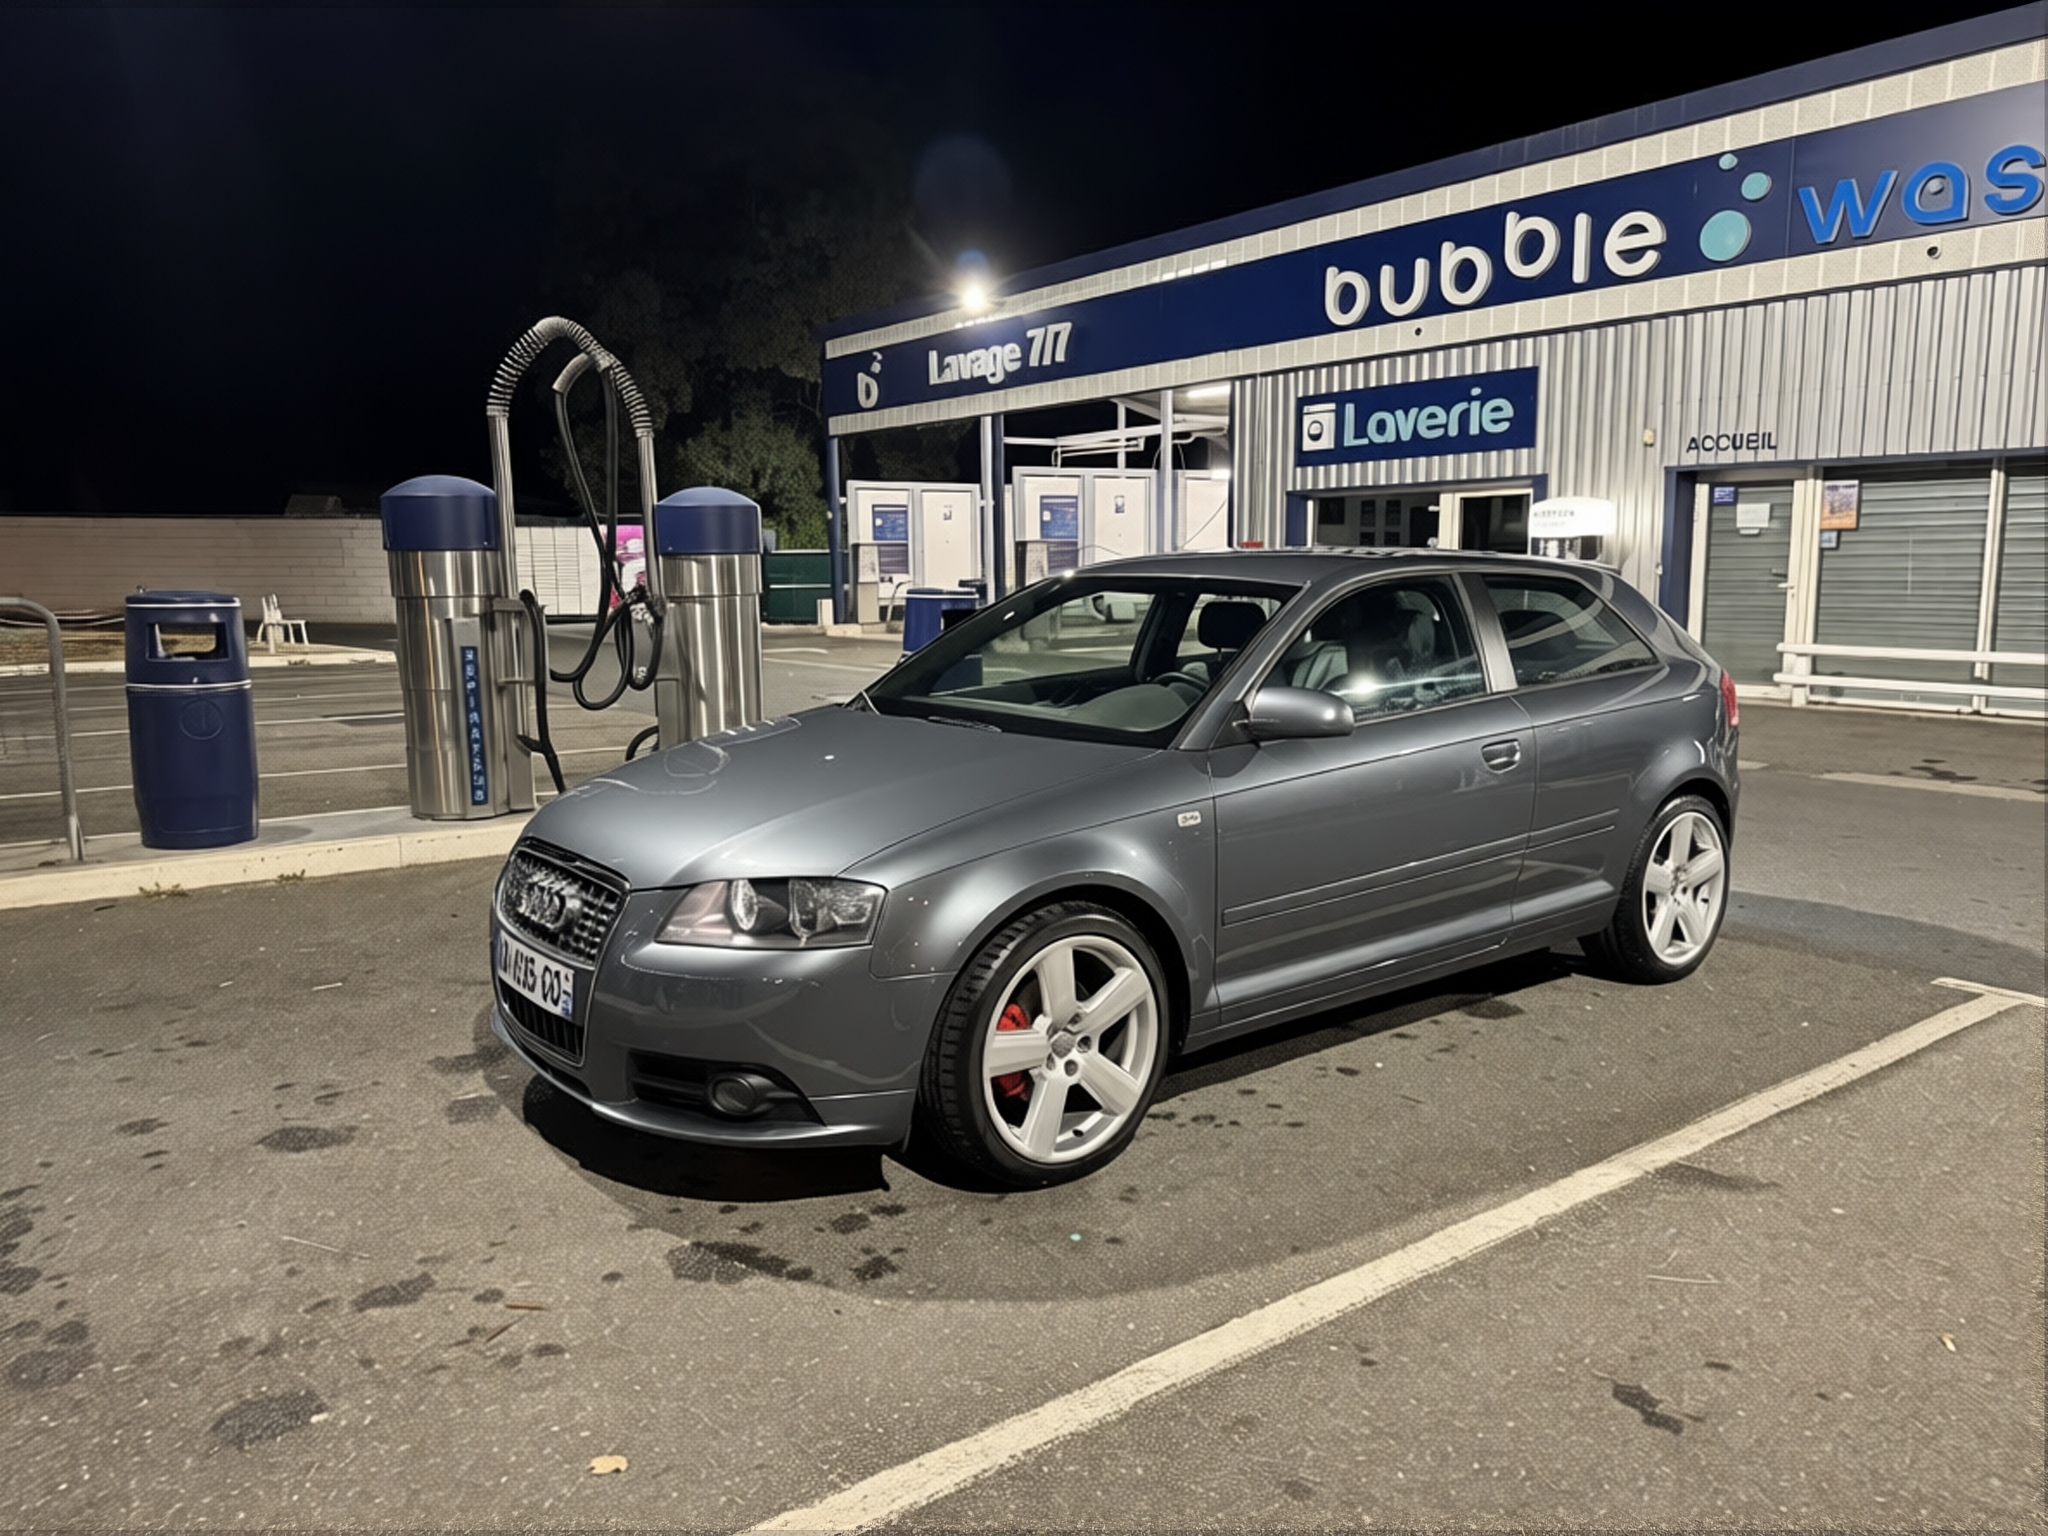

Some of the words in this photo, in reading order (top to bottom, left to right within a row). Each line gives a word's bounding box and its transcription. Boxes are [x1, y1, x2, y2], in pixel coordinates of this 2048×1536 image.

[1324, 210, 1667, 326] bubble
[1798, 144, 2047, 245] was
[928, 342, 1022, 386] Lavage
[1343, 386, 1514, 447] Laverie
[1686, 432, 1777, 453] ACCUEIL
